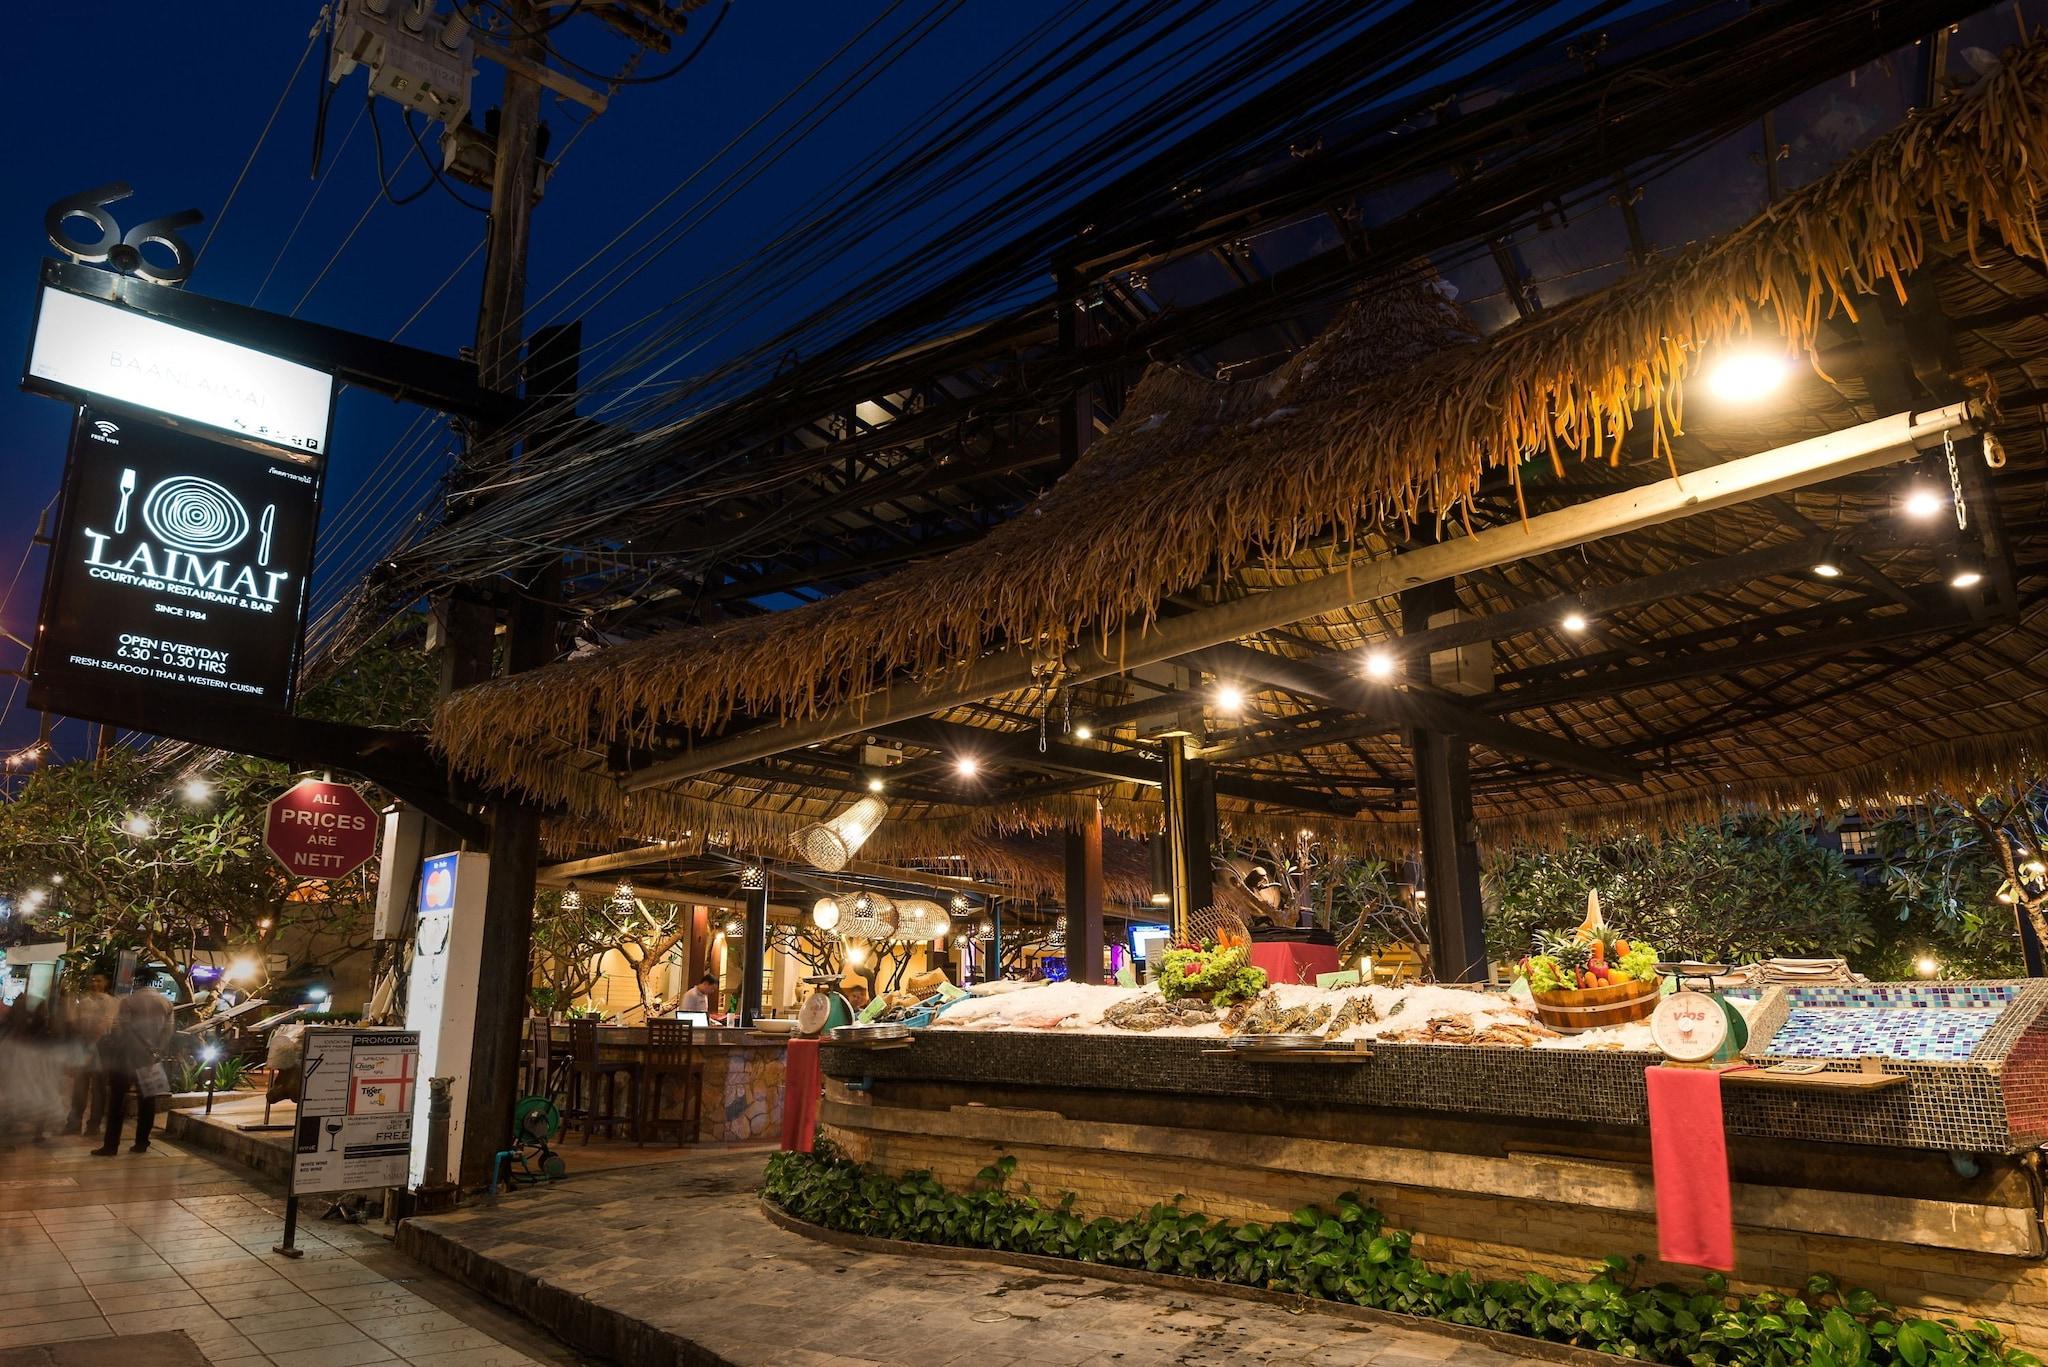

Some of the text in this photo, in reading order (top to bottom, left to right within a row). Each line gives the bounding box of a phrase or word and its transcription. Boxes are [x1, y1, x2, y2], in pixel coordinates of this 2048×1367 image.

[46, 180, 205, 286] 66
[90, 433, 106, 442] FREE
[84, 527, 289, 603] LAIMAI
[89, 567, 274, 613] COURTYARD RESTAURANT & BAR
[154, 603, 207, 620] SINCE 1984
[119, 633, 230, 662] OPEN EVERYDAY
[117, 646, 151, 661] 6.30
[162, 653, 196, 669] 0.30
[198, 659, 227, 674] HRS
[69, 655, 100, 668] FRESH
[100, 660, 149, 676] SEAFOOD
[155, 669, 176, 681] THAI
[178, 674, 186, 682] &
[187, 675, 228, 689] WESTERN
[229, 682, 265, 695] CUISINE
[312, 793, 340, 806] ALL
[280, 809, 366, 831] PRICES
[306, 834, 337, 847] ARE
[294, 851, 344, 868] NETT
[354, 1036, 418, 1045] PROMOTION
[361, 1086, 382, 1097] Tiger
[376, 1131, 410, 1141] FREE
